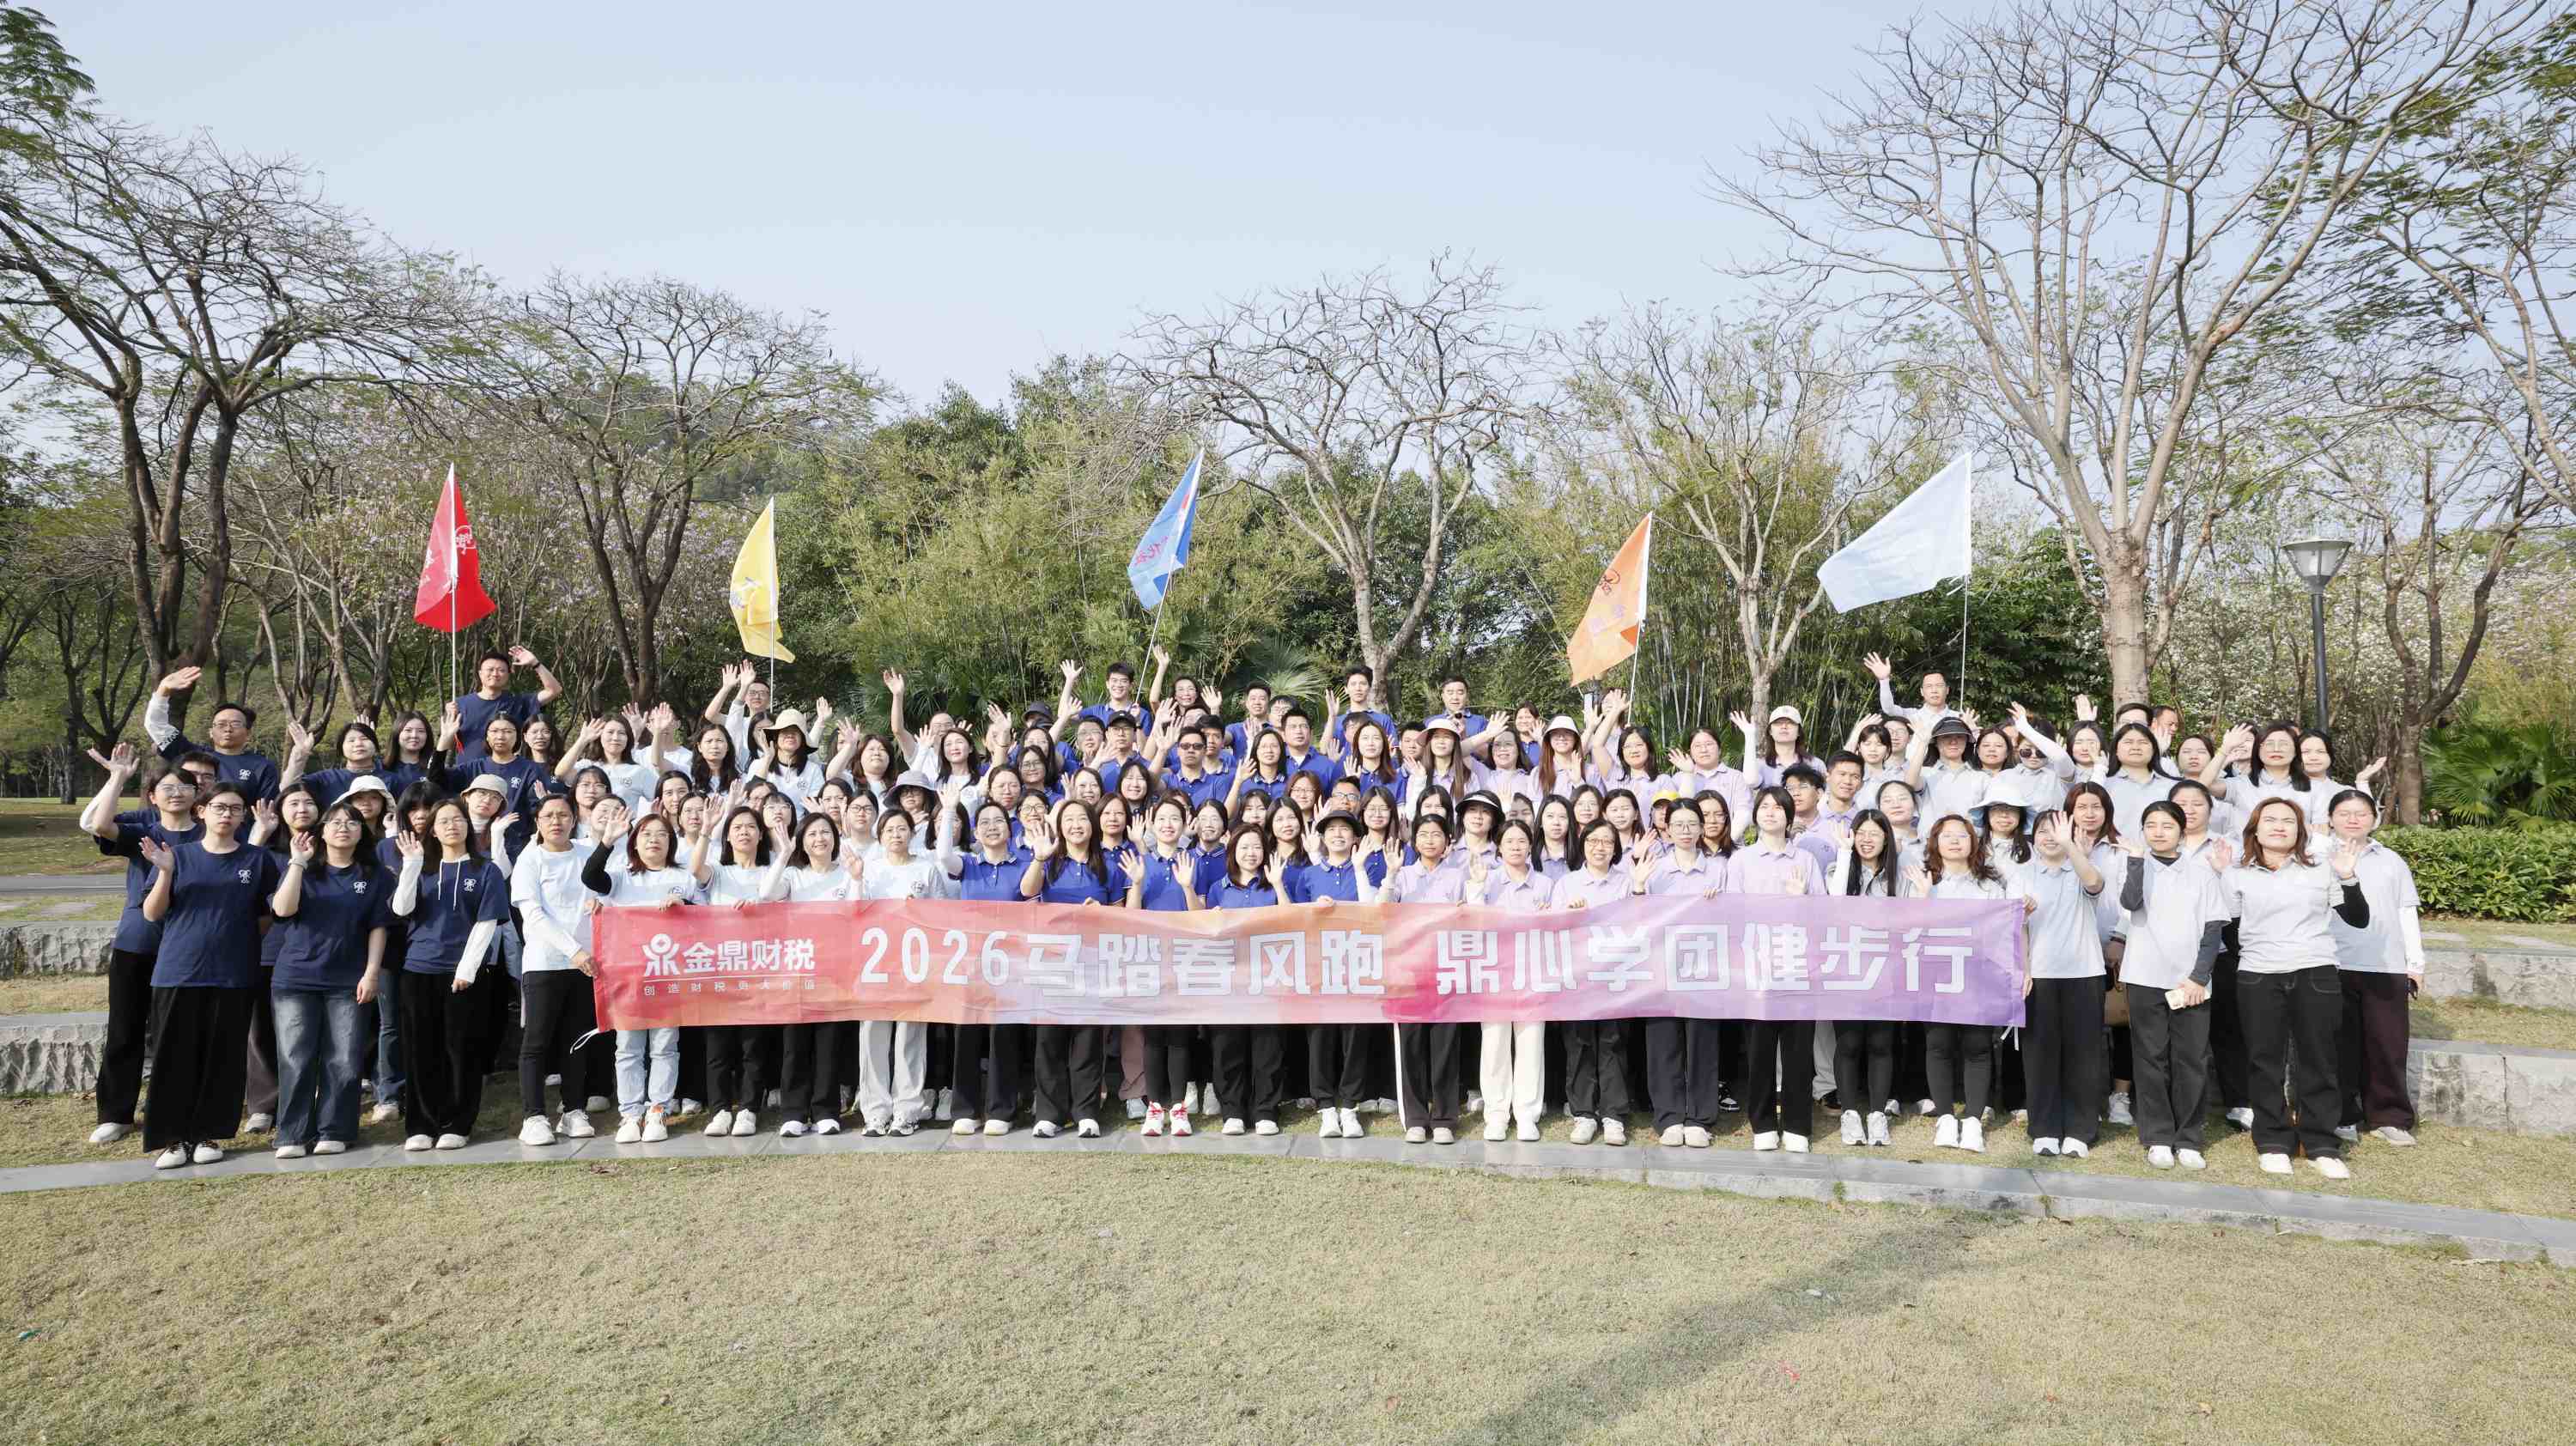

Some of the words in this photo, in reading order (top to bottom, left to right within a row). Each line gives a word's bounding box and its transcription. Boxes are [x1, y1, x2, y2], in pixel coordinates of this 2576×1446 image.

[683, 939, 816, 974] 金鼎财税
[1436, 922, 1973, 994] 鼎心学团健步行
